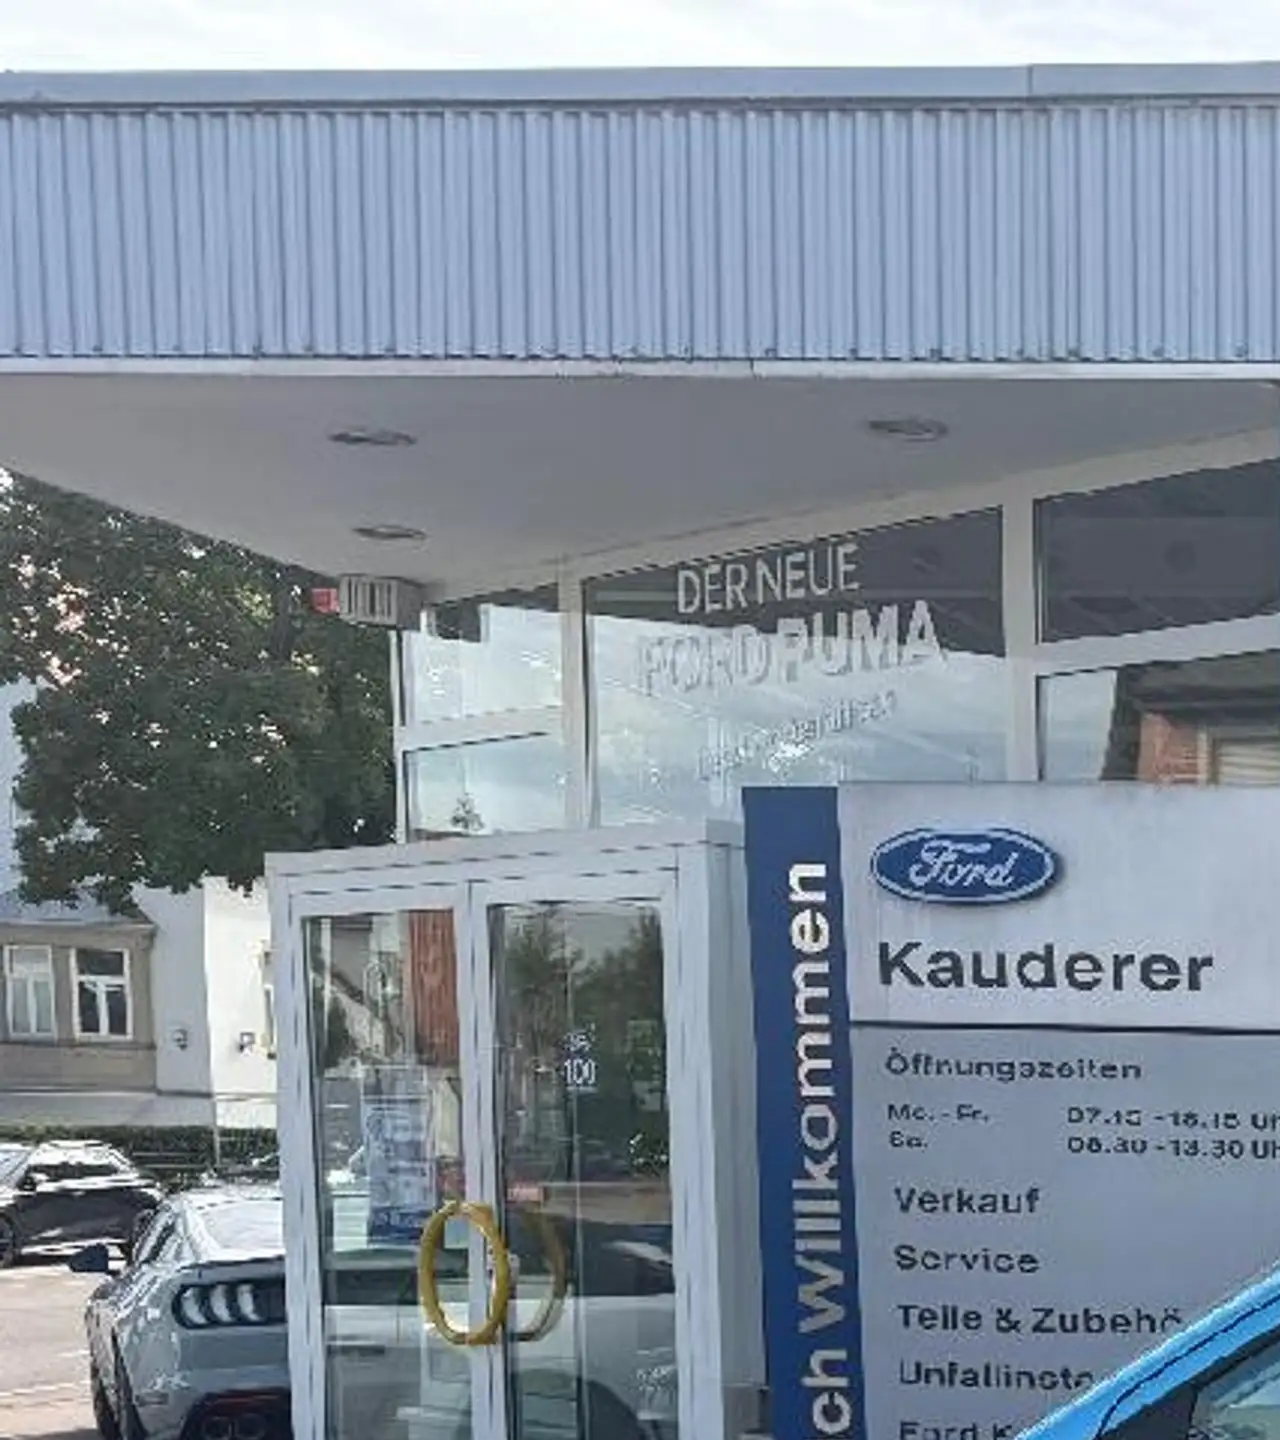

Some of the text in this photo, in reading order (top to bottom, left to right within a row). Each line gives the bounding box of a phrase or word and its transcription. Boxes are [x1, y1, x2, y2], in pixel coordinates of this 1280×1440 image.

[677, 543, 860, 614] DER NEUE
[777, 599, 945, 682] PUMA
[879, 941, 1213, 993] Kauderer
[885, 1047, 1142, 1083] Öffnungszeiten
[788, 863, 843, 1331] Willkommen
[895, 1187, 1042, 1214] Verkauf
[894, 1244, 1041, 1274] Service
[898, 1304, 1182, 1334] Teile & Zubehö
